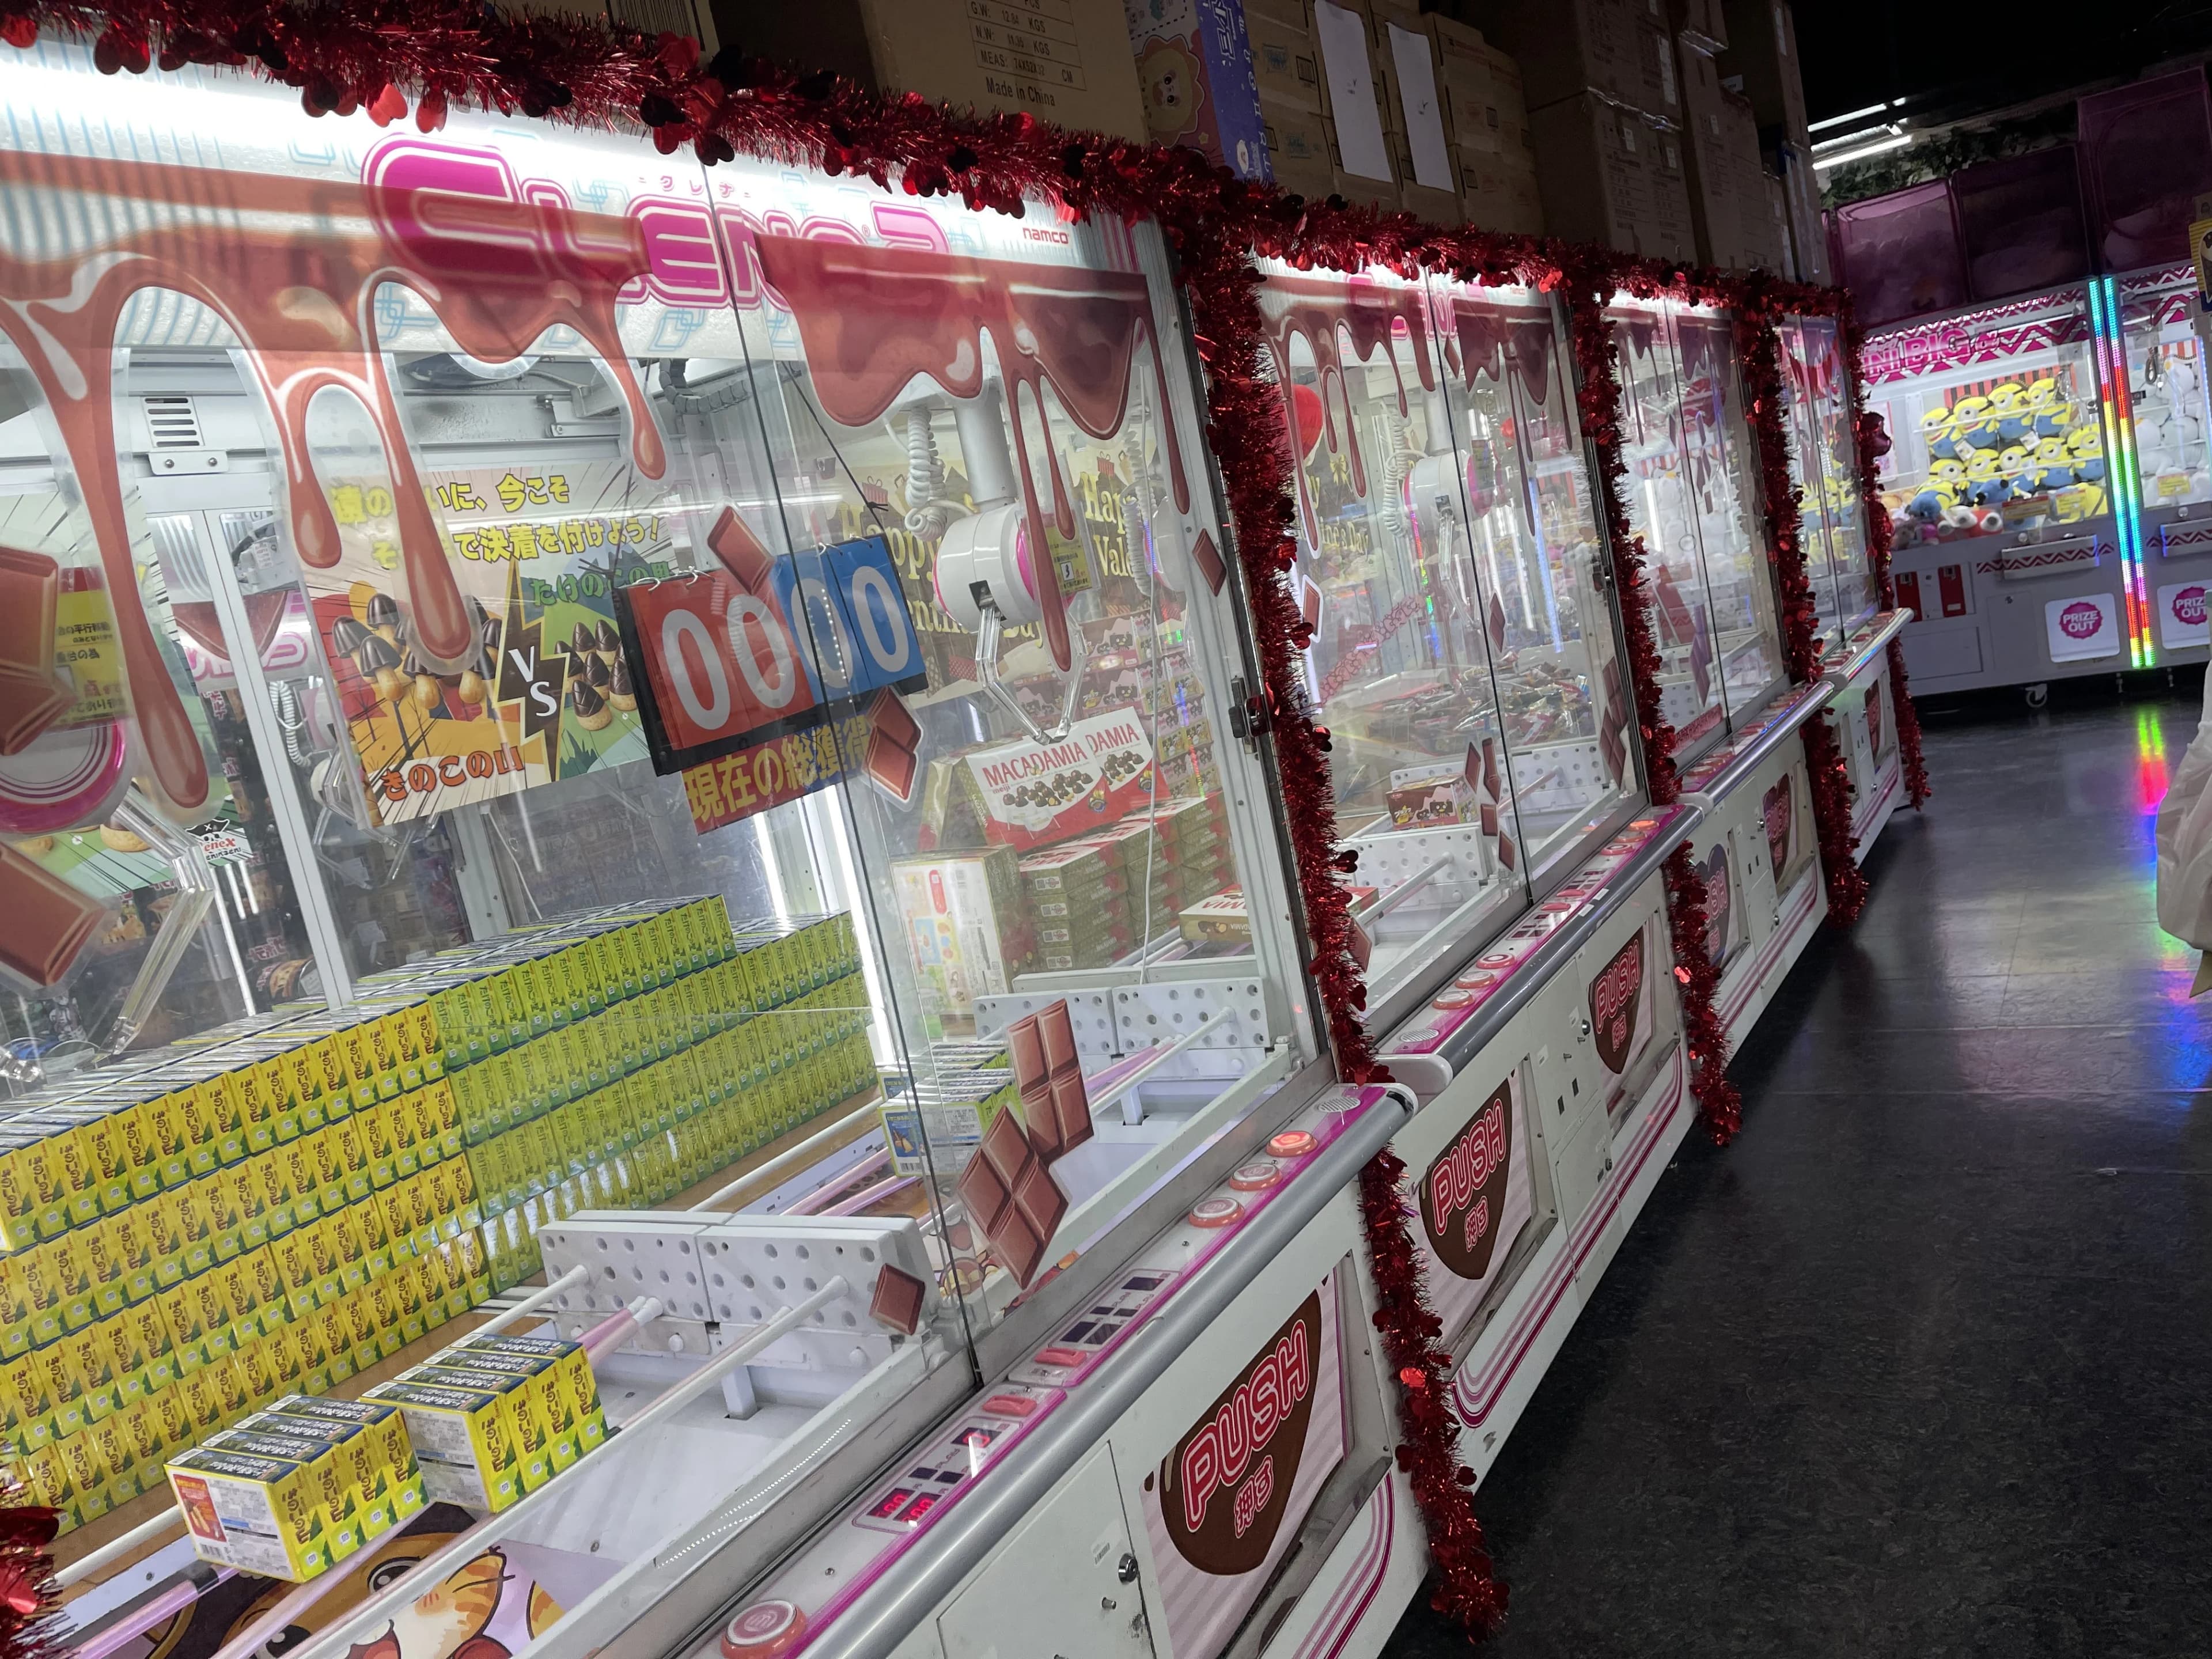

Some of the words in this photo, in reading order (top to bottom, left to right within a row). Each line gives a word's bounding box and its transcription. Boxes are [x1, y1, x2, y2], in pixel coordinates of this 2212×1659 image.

[1028, 17, 1046, 33] KGS
[1033, 41, 1050, 56] KGS
[980, 50, 1007, 67] MEAS:
[1062, 69, 1074, 84] CM
[986, 77, 1013, 97] Made
[1015, 82, 1025, 101] in
[1028, 85, 1056, 106] China
[1022, 227, 1070, 245] namco
[1904, 327, 1971, 370] BIG
[2062, 610, 2099, 625] PRIZE
[2067, 619, 2096, 633] OUT
[2175, 596, 2205, 610] PRIZ
[507, 646, 558, 717] VS
[380, 743, 524, 801] きのこの山
[982, 741, 1088, 788] MACADAMIA
[992, 783, 1012, 795] meiji
[1593, 938, 1641, 1035] PUSH
[1431, 1097, 1506, 1237] PUSH
[1464, 1195, 1489, 1253] 押す
[540, 1380, 565, 1433] きのこの山
[567, 1362, 593, 1415] きのこの山
[480, 1416, 506, 1472] きのこの山
[512, 1398, 537, 1453] きのこの山
[1181, 1319, 1310, 1534] PUSH
[350, 1445, 376, 1501] きのこの山
[382, 1429, 407, 1483] きのこの山
[283, 1486, 310, 1544] きのこの山
[318, 1465, 344, 1522] きのこの山
[1233, 1454, 1275, 1540] 押す
